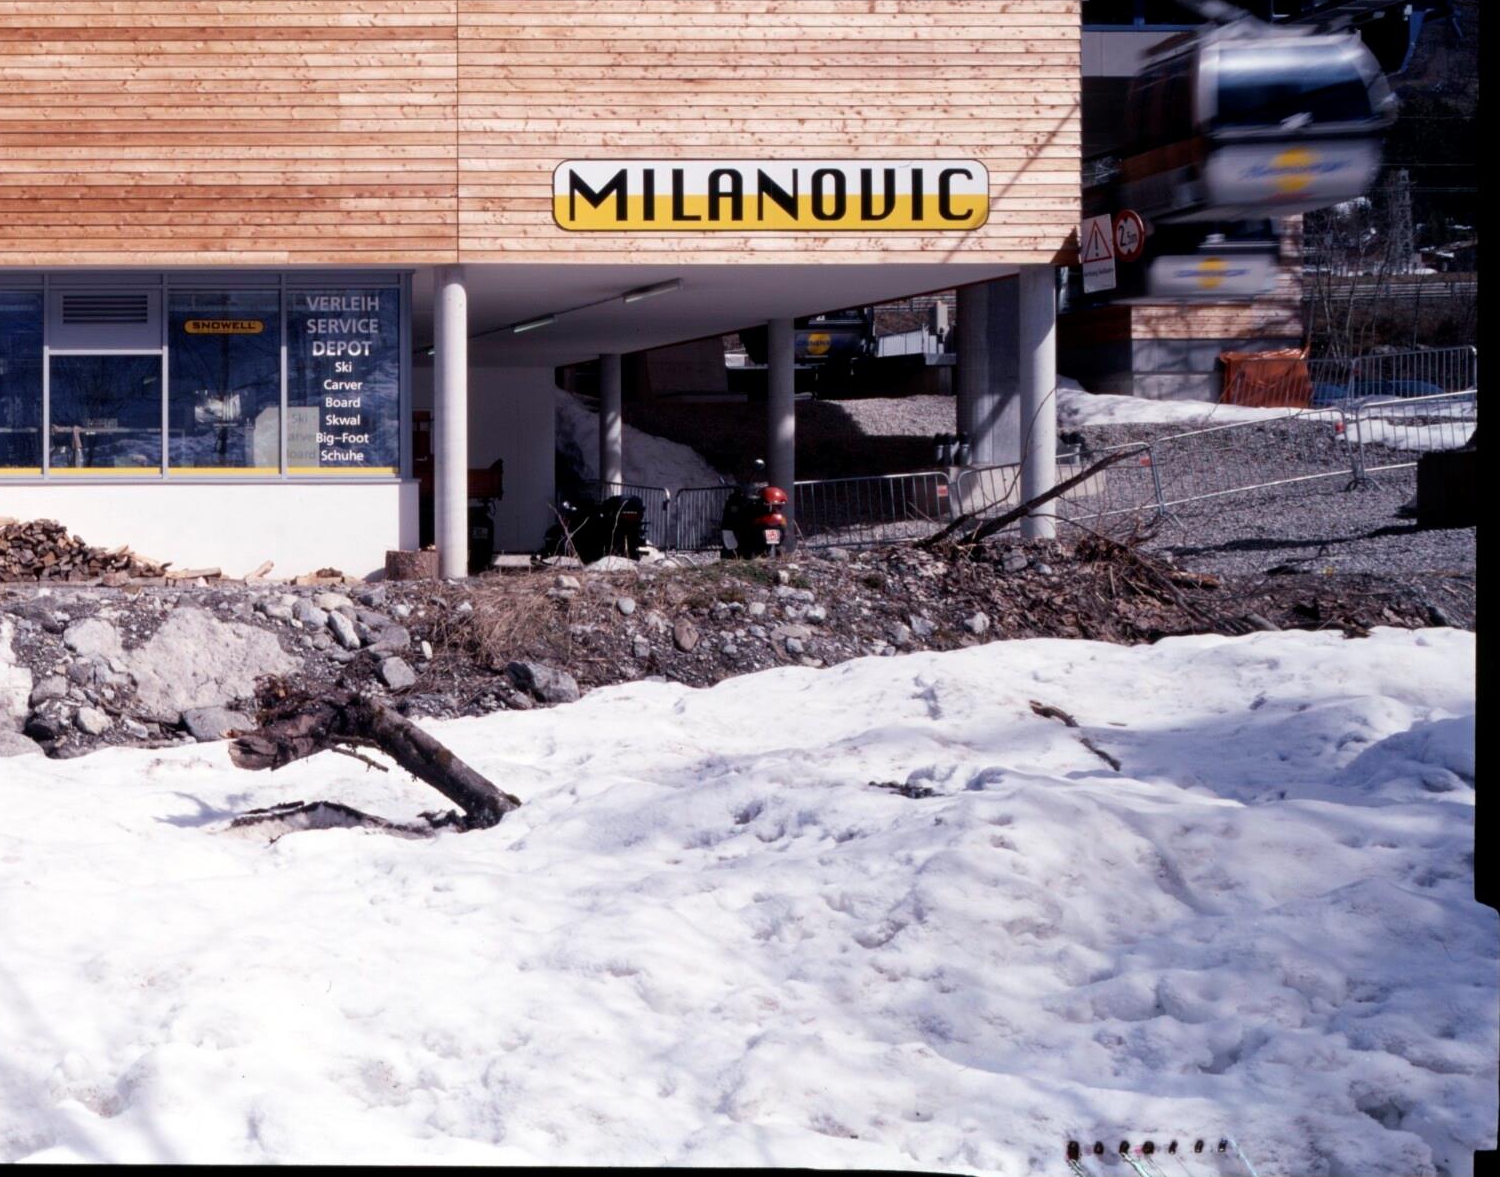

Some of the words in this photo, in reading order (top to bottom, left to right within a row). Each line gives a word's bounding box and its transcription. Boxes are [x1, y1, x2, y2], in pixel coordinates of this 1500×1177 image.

[568, 167, 974, 222] MILANOVIC
[306, 296, 380, 311] VERLEIH
[192, 321, 256, 330] SNOWELL
[306, 318, 379, 334] SERVICE
[312, 340, 373, 356] DEPOT
[334, 361, 353, 373] Ski
[323, 379, 363, 390] Carver
[325, 396, 361, 408] Board
[325, 414, 361, 426] Skwal
[315, 431, 370, 446] Big-Foot
[320, 450, 364, 461] Schuhe
